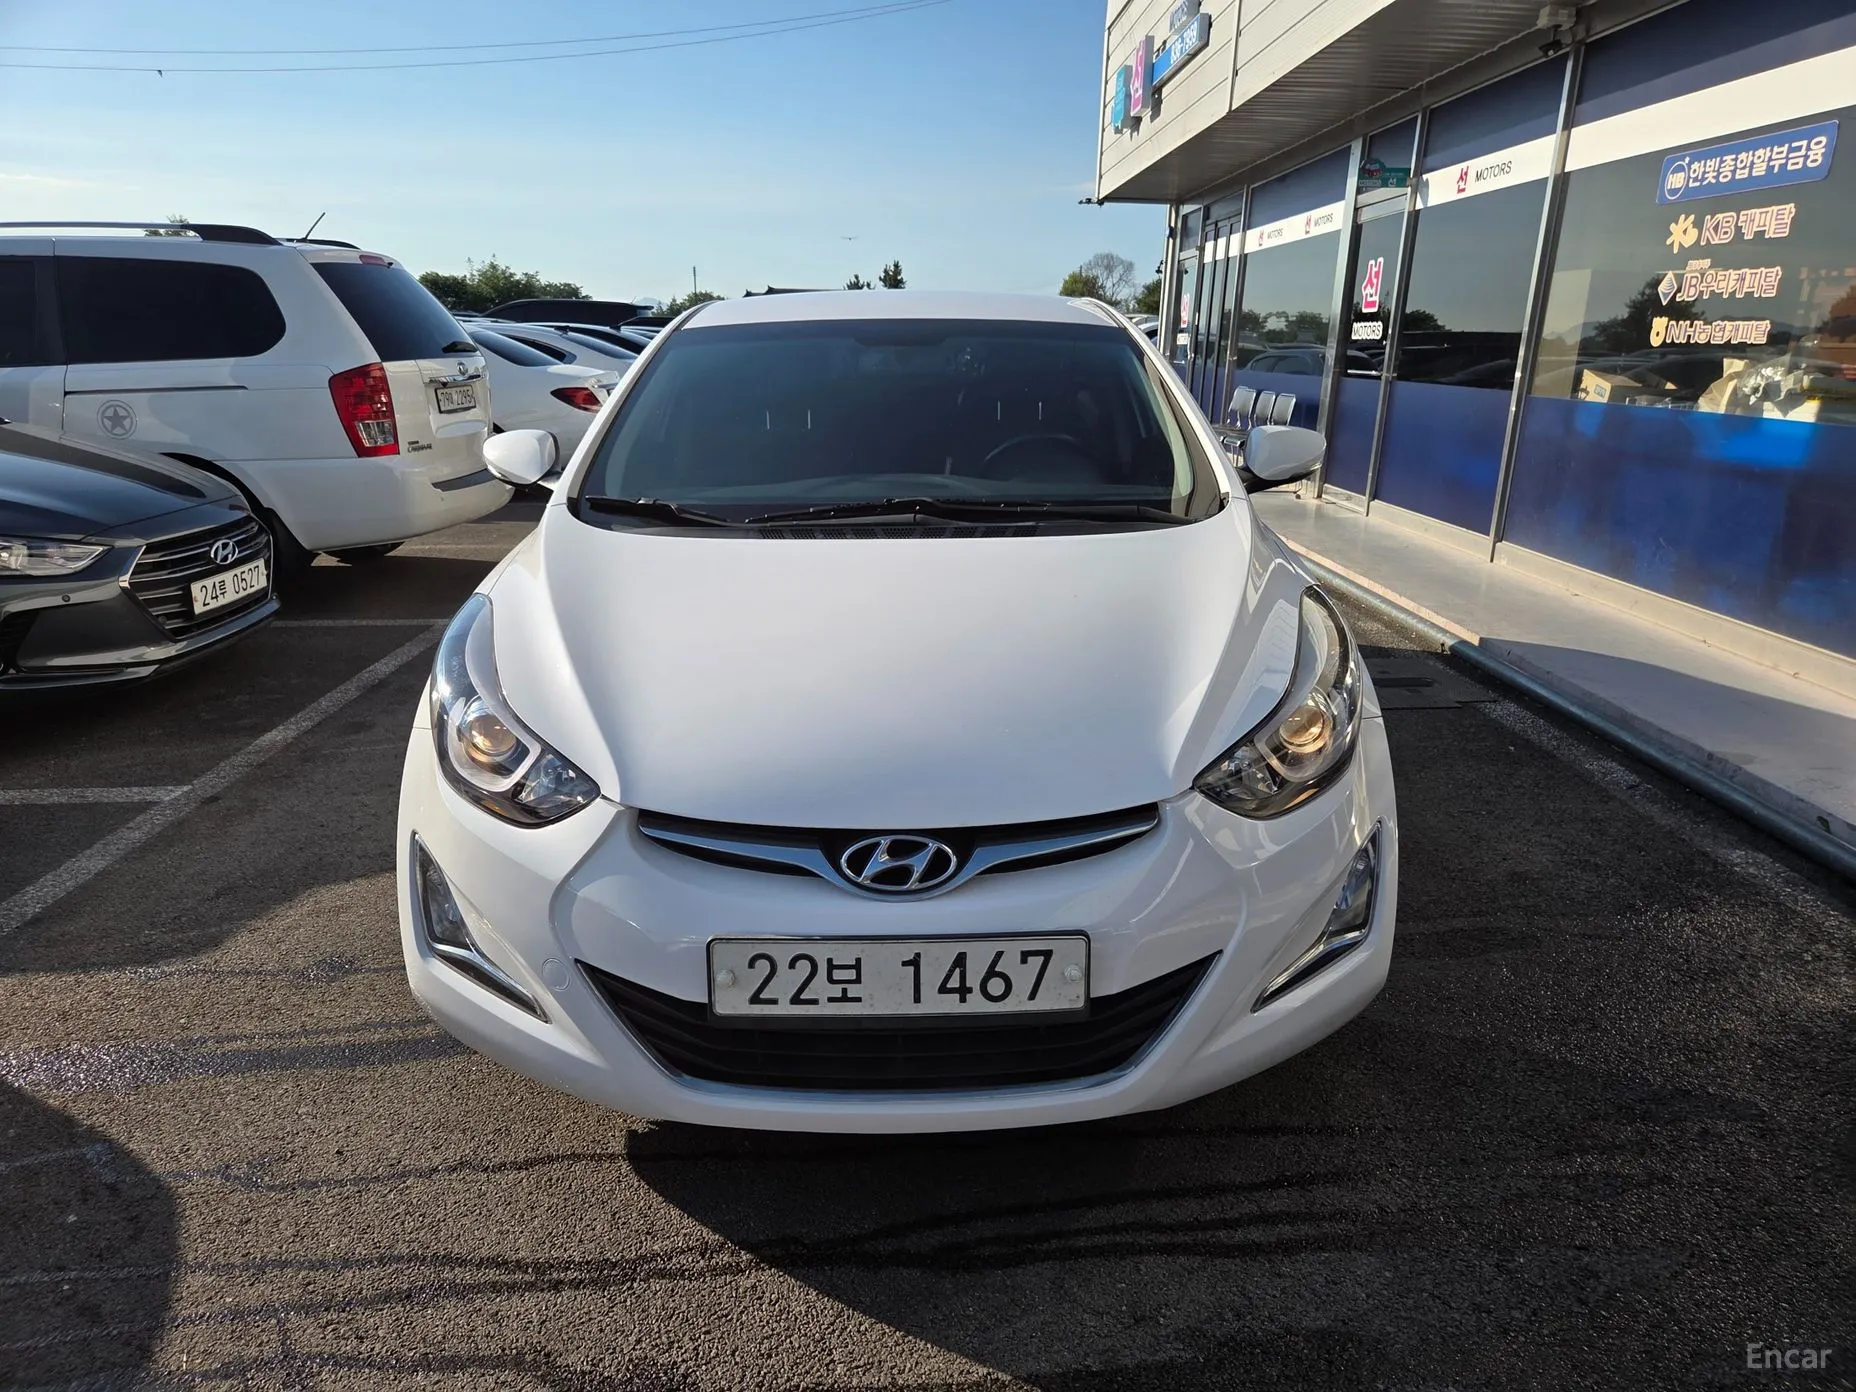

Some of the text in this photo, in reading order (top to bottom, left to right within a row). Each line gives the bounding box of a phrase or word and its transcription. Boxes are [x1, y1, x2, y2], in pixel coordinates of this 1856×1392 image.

[1475, 160, 1513, 183] MOTORS
[1688, 136, 1827, 188] 한빛종합할부금융
[1314, 212, 1334, 227] MOTORS
[1700, 203, 1796, 246] KB 캐피탈
[1361, 256, 1384, 313] 선
[1352, 322, 1383, 340] MOTORS
[200, 565, 261, 608] 24루 0527
[747, 949, 1054, 1006] 22보 1467
